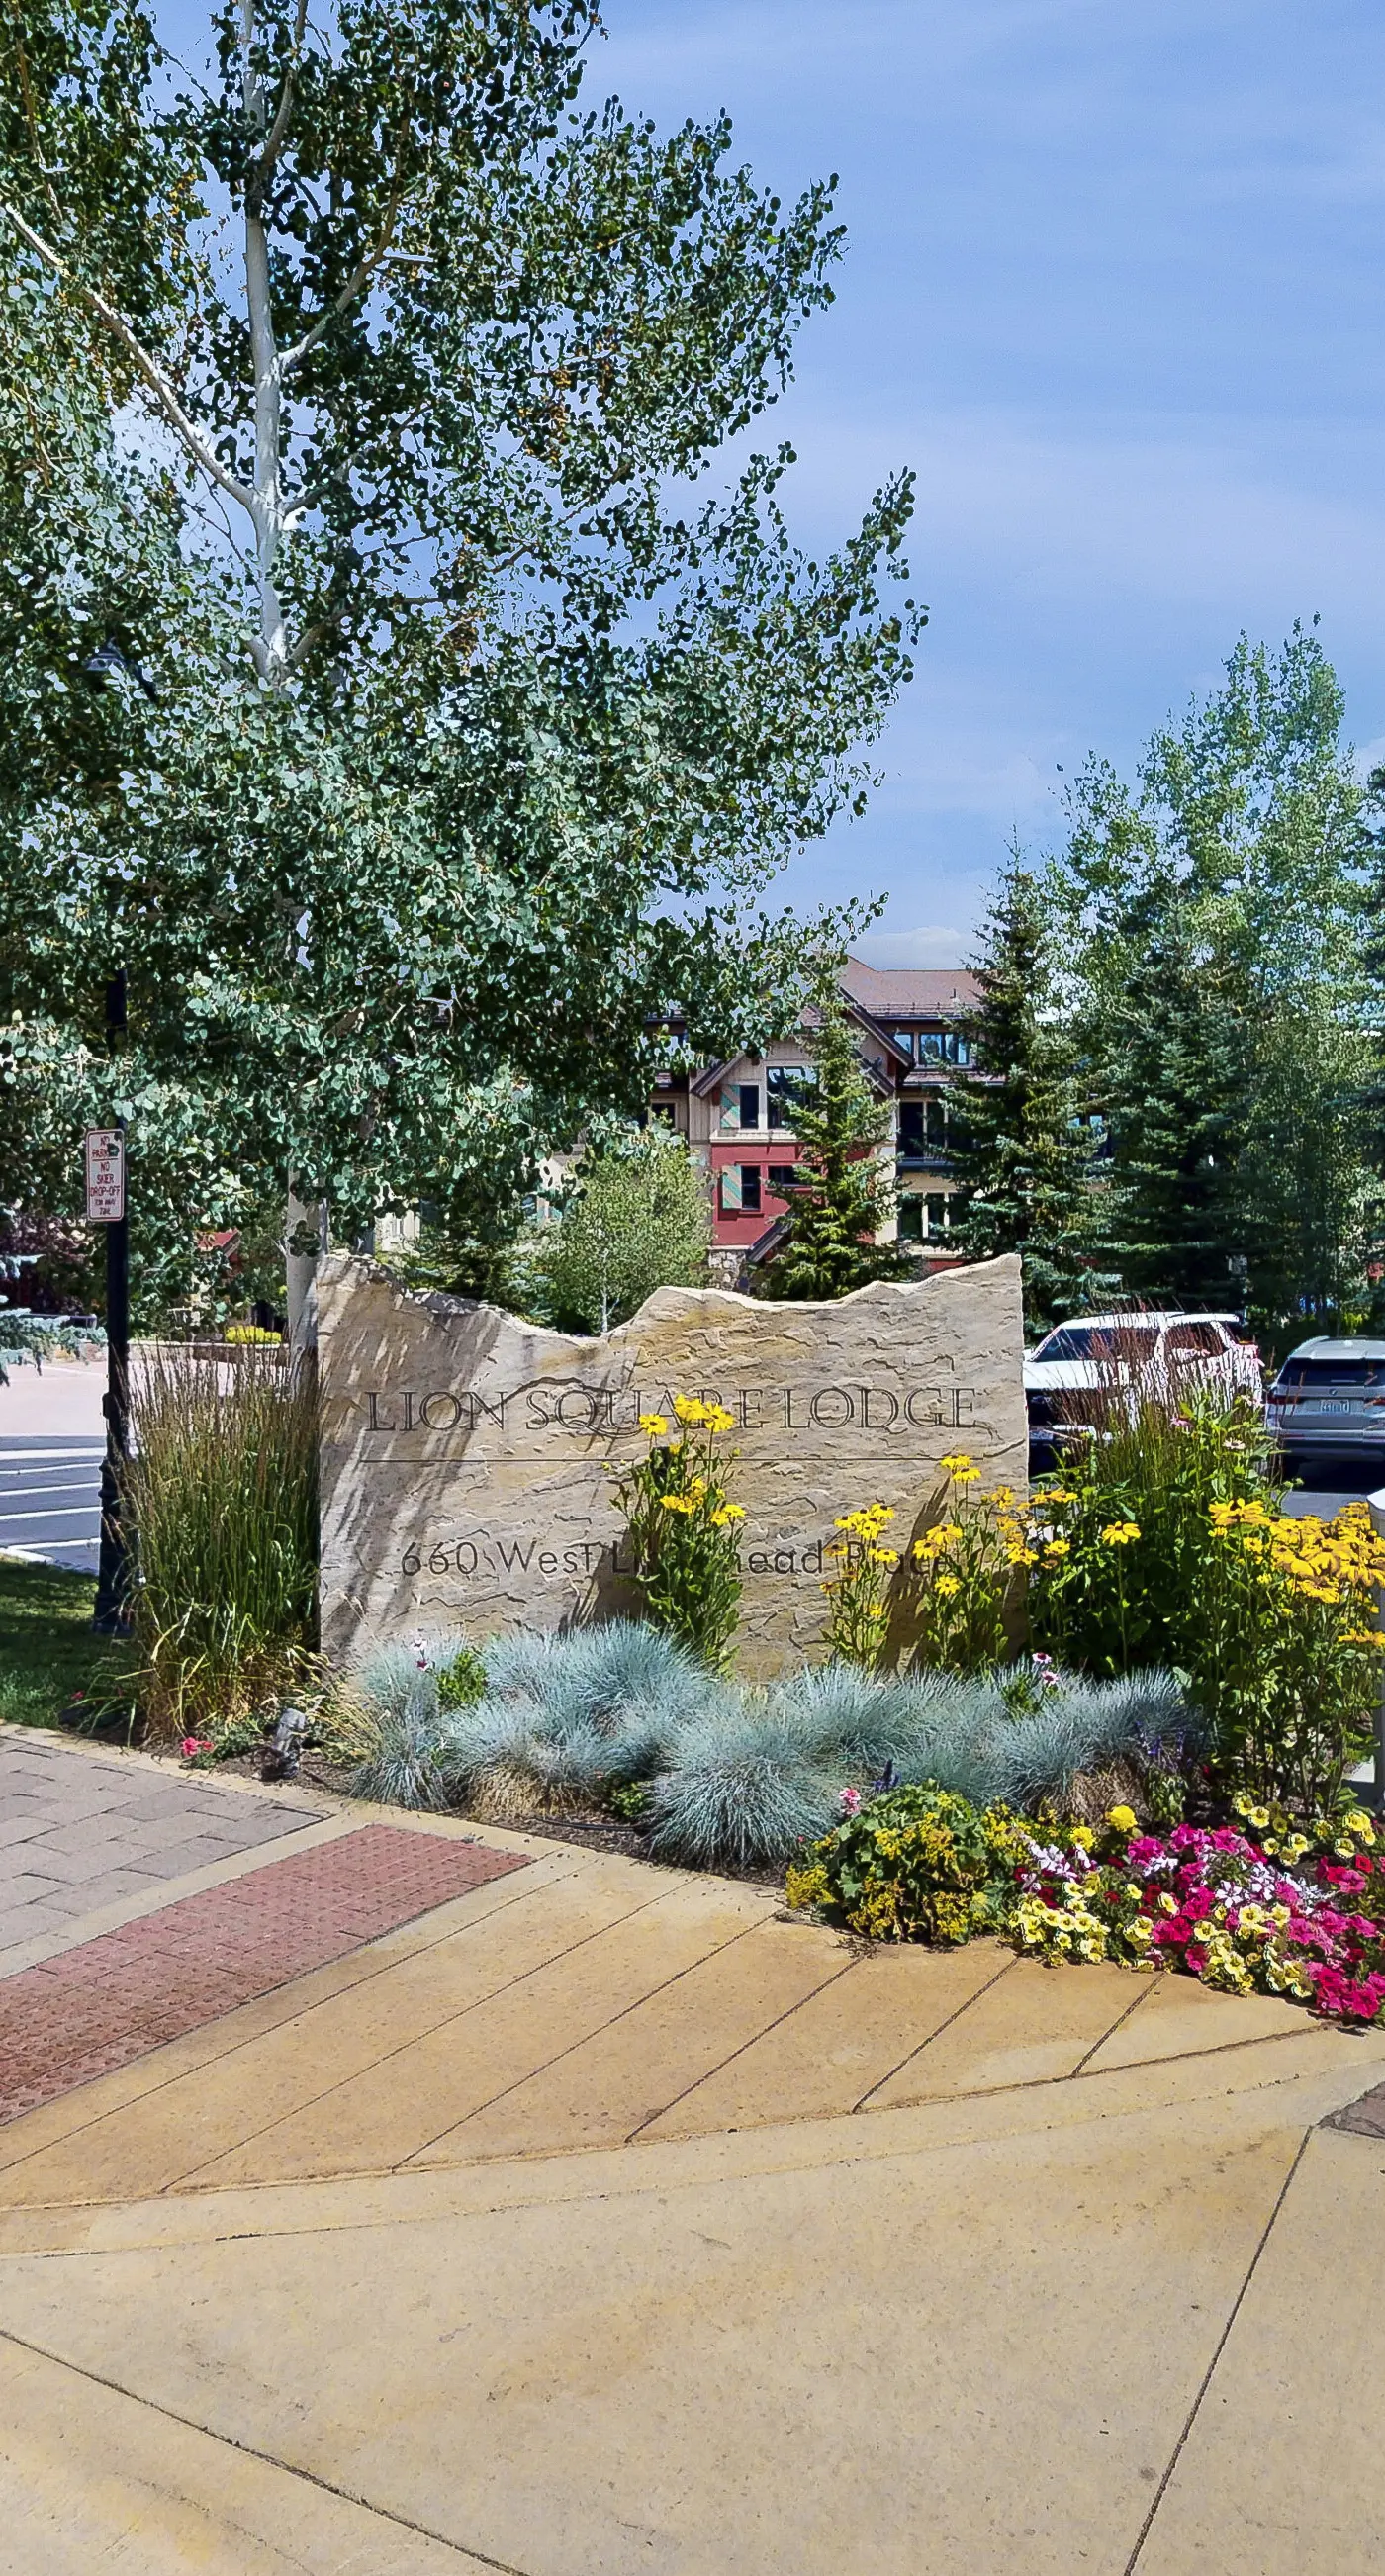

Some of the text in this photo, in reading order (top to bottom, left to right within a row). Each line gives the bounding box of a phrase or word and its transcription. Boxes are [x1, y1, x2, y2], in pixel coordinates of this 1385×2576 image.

[100, 1161, 110, 1172] NO
[364, 1390, 508, 1432] LION
[780, 1387, 976, 1429] LODGE
[402, 1541, 478, 1576] 660
[496, 1540, 593, 1574] West
